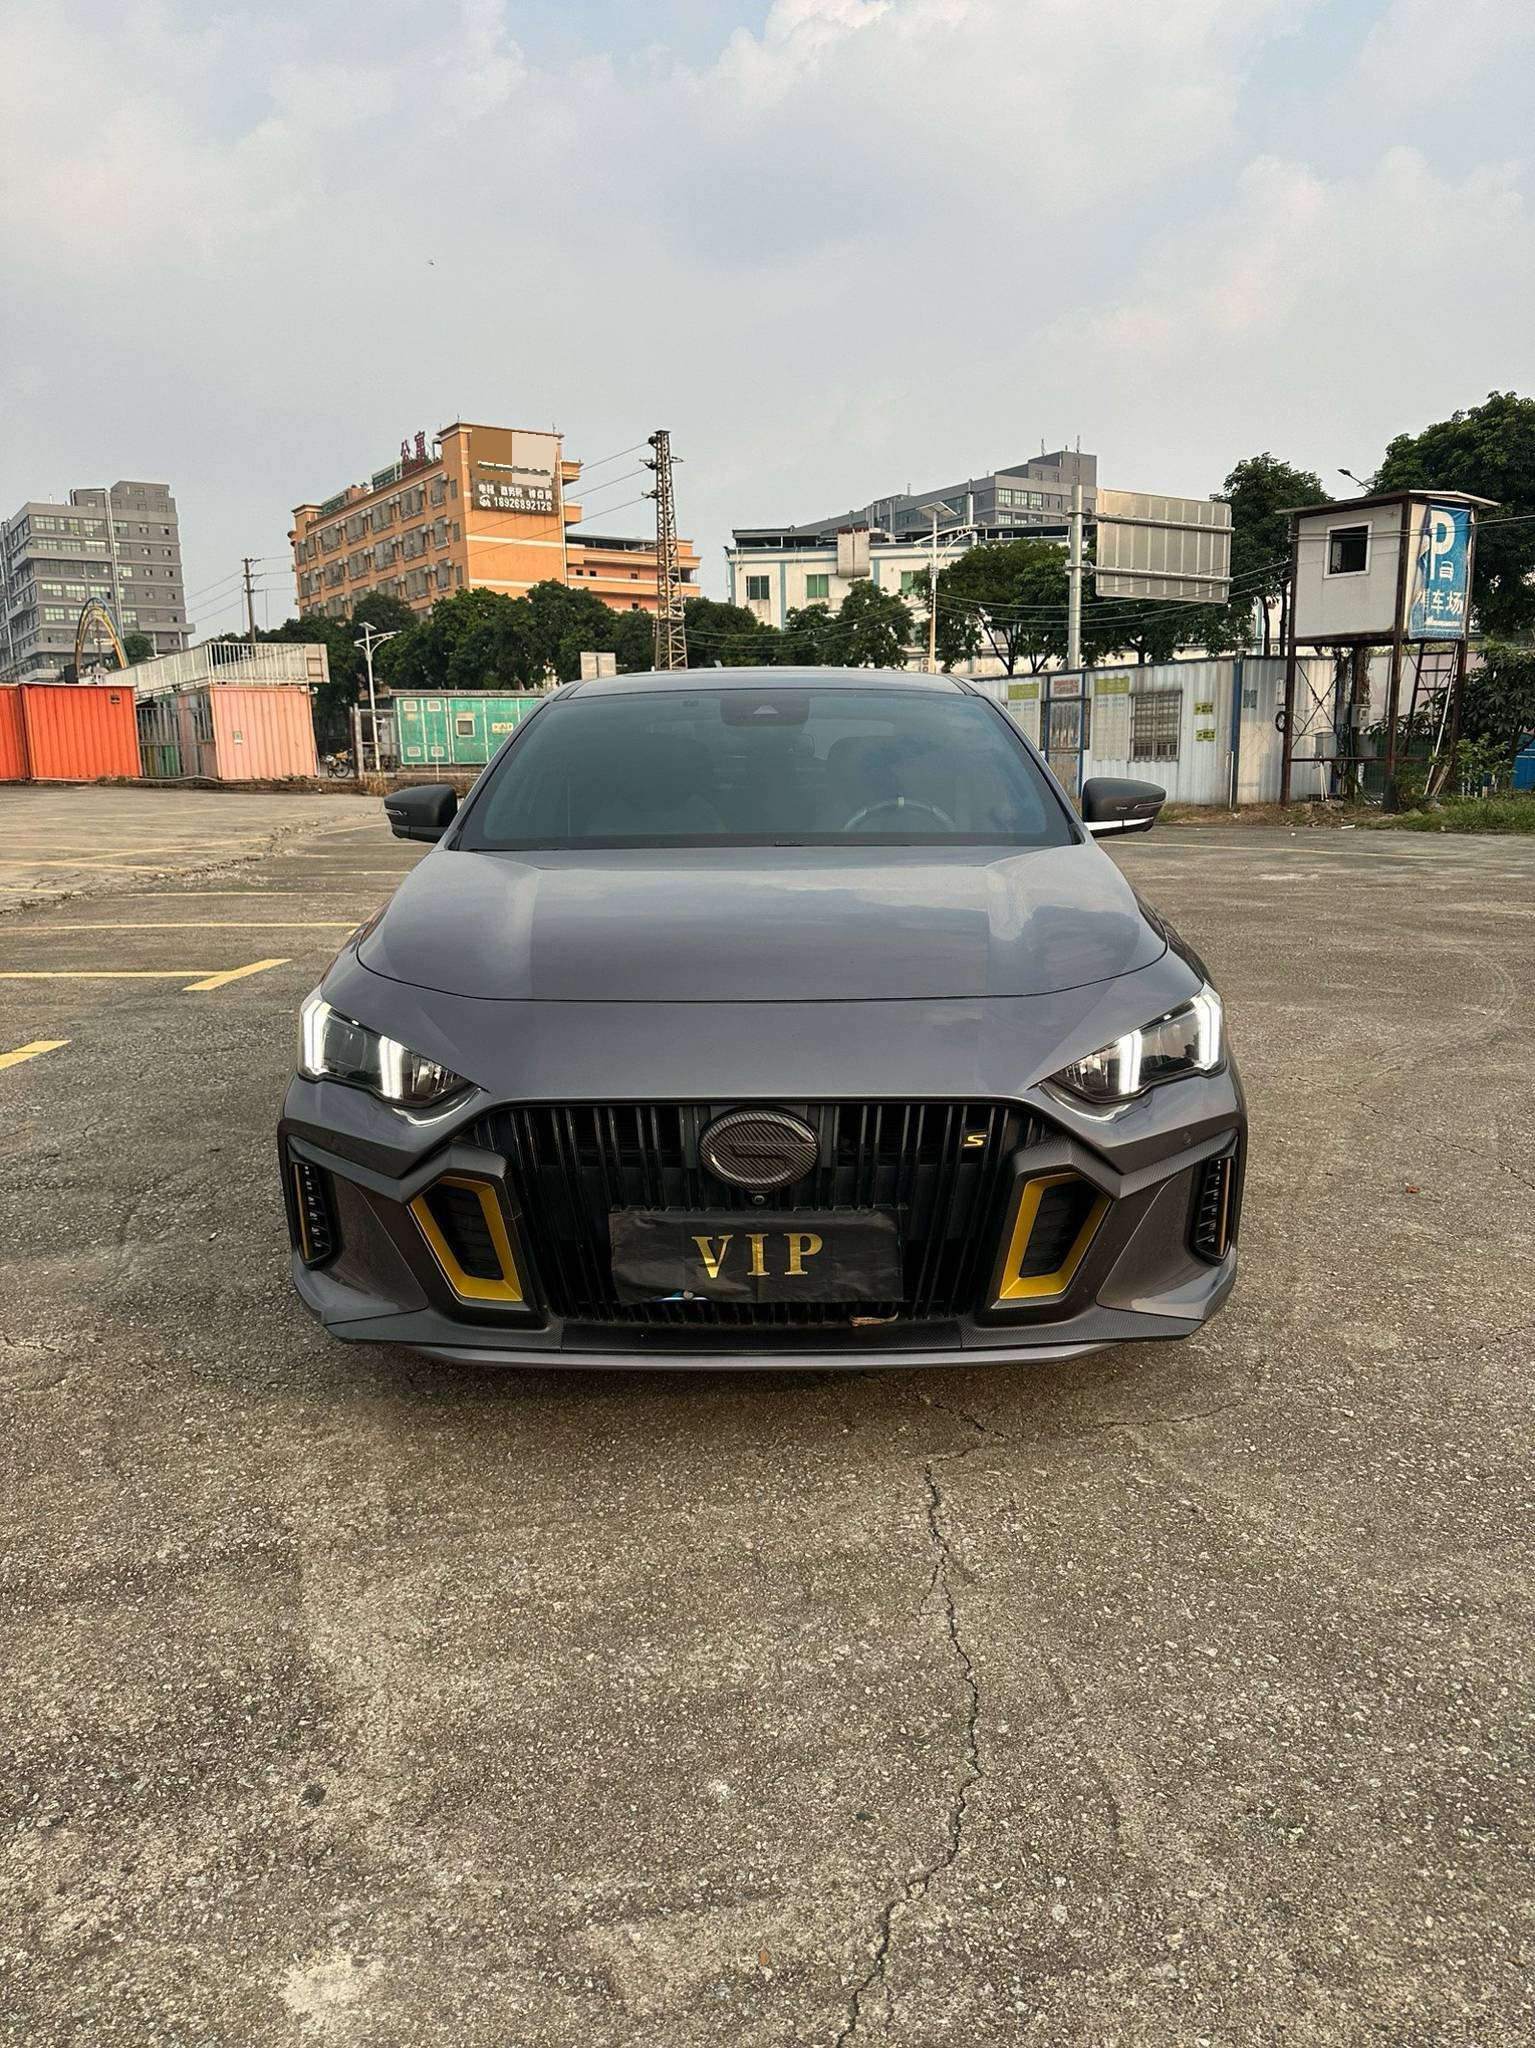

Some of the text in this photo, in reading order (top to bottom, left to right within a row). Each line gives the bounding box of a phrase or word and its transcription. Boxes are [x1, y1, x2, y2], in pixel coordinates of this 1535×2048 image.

[1430, 510, 1456, 580] P
[963, 1134, 988, 1148] S
[690, 1232, 825, 1280] VIP
